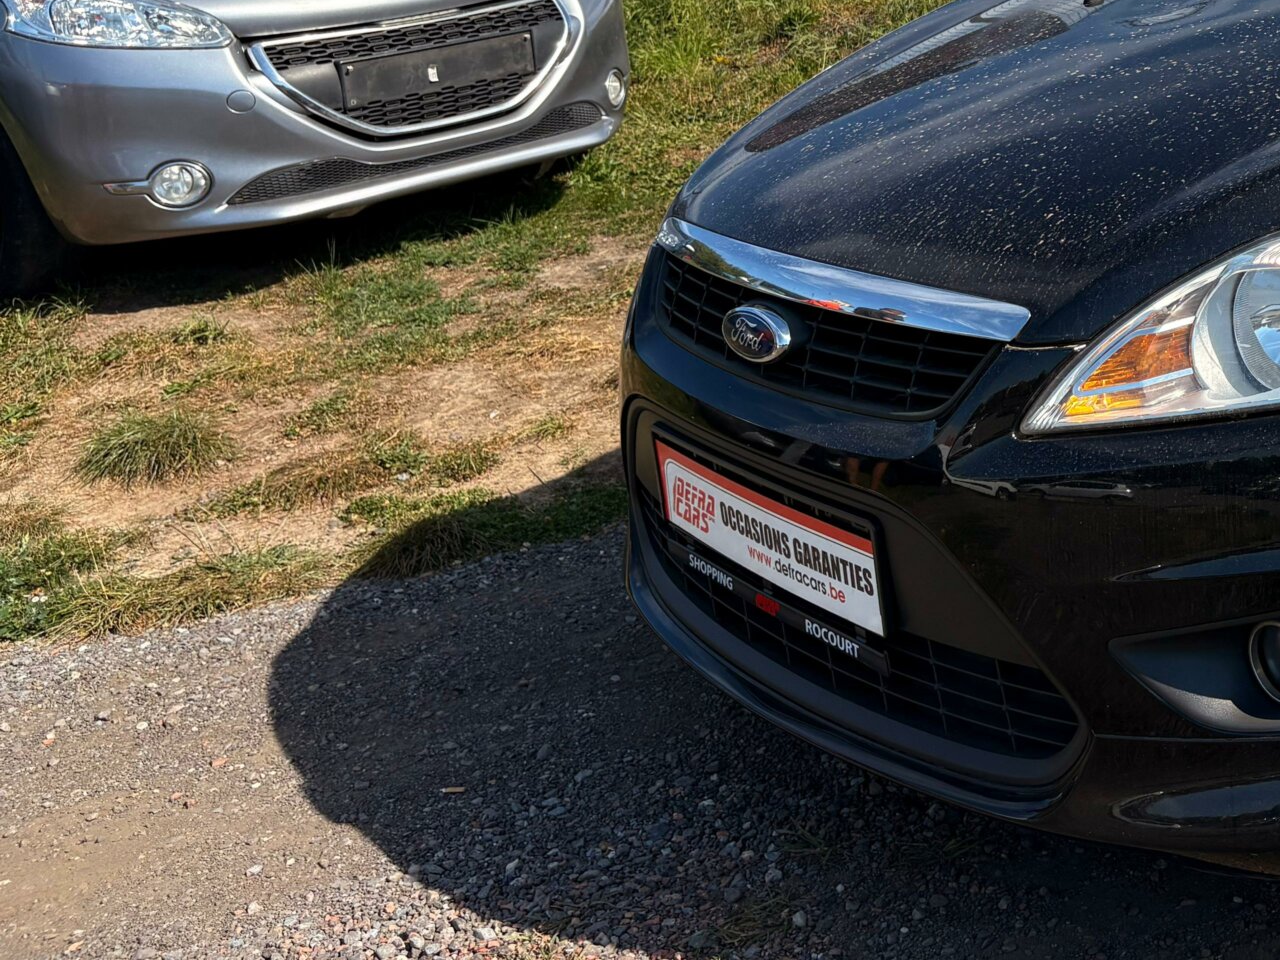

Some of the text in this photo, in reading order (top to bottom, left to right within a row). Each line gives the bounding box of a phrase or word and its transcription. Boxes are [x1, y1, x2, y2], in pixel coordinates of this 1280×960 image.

[731, 317, 764, 352] Ford
[676, 477, 715, 518] DEFRA
[676, 496, 709, 534] CARS
[720, 501, 875, 597] OCCASIONS GARANTIES
[689, 553, 734, 591] SHOPPING
[804, 618, 860, 659] ROCOURT
